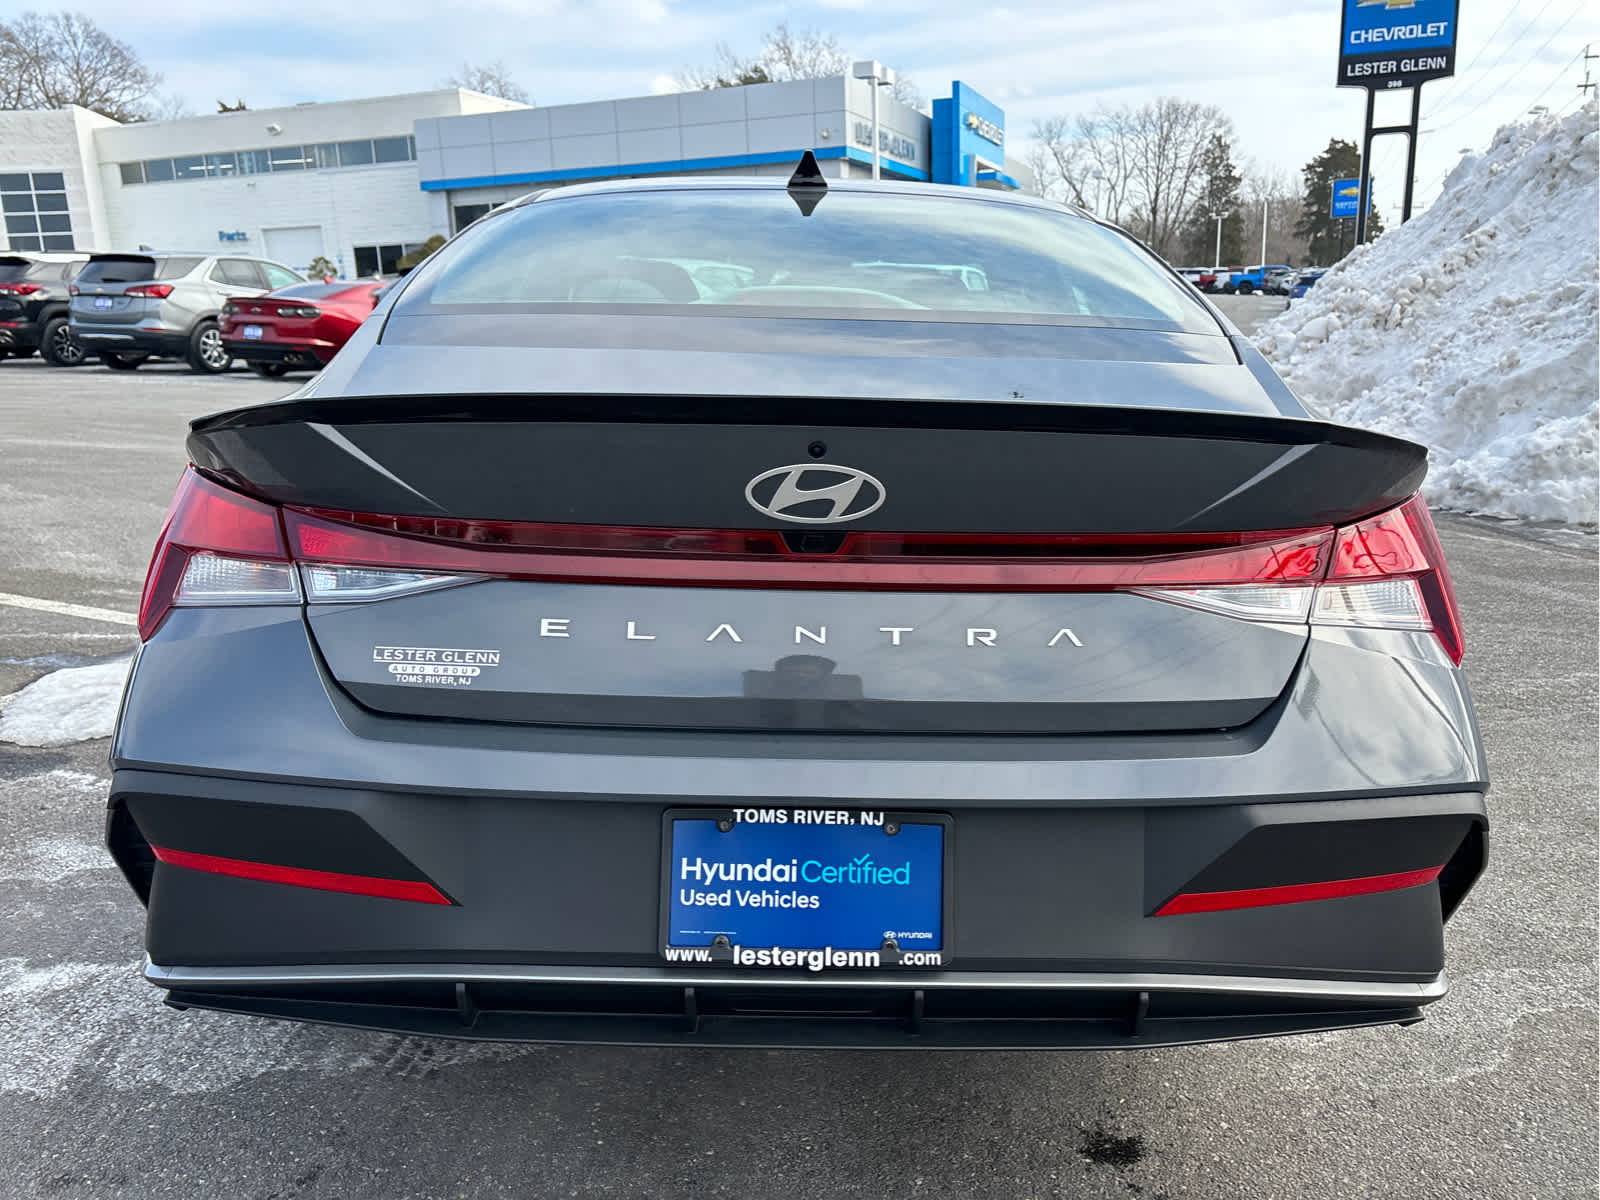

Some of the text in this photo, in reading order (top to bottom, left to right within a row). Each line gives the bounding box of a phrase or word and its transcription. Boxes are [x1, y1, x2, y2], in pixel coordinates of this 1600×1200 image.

[1350, 22, 1448, 44] CHEVROLET
[1347, 56, 1447, 77] LESTER GLENN
[540, 617, 1083, 647] ELANTRA
[373, 649, 500, 664] LESTER GLENN
[391, 665, 477, 675] AUTO GROUP
[395, 674, 472, 686] TOMS RIVER, NJ
[733, 808, 884, 826] TOMS RIVER, NJ
[680, 853, 911, 886] Hyundai Certified
[679, 889, 820, 909] Used Vehicles
[898, 931, 933, 939] HYUNDAI
[665, 946, 942, 972] www. lesterglenn .com
